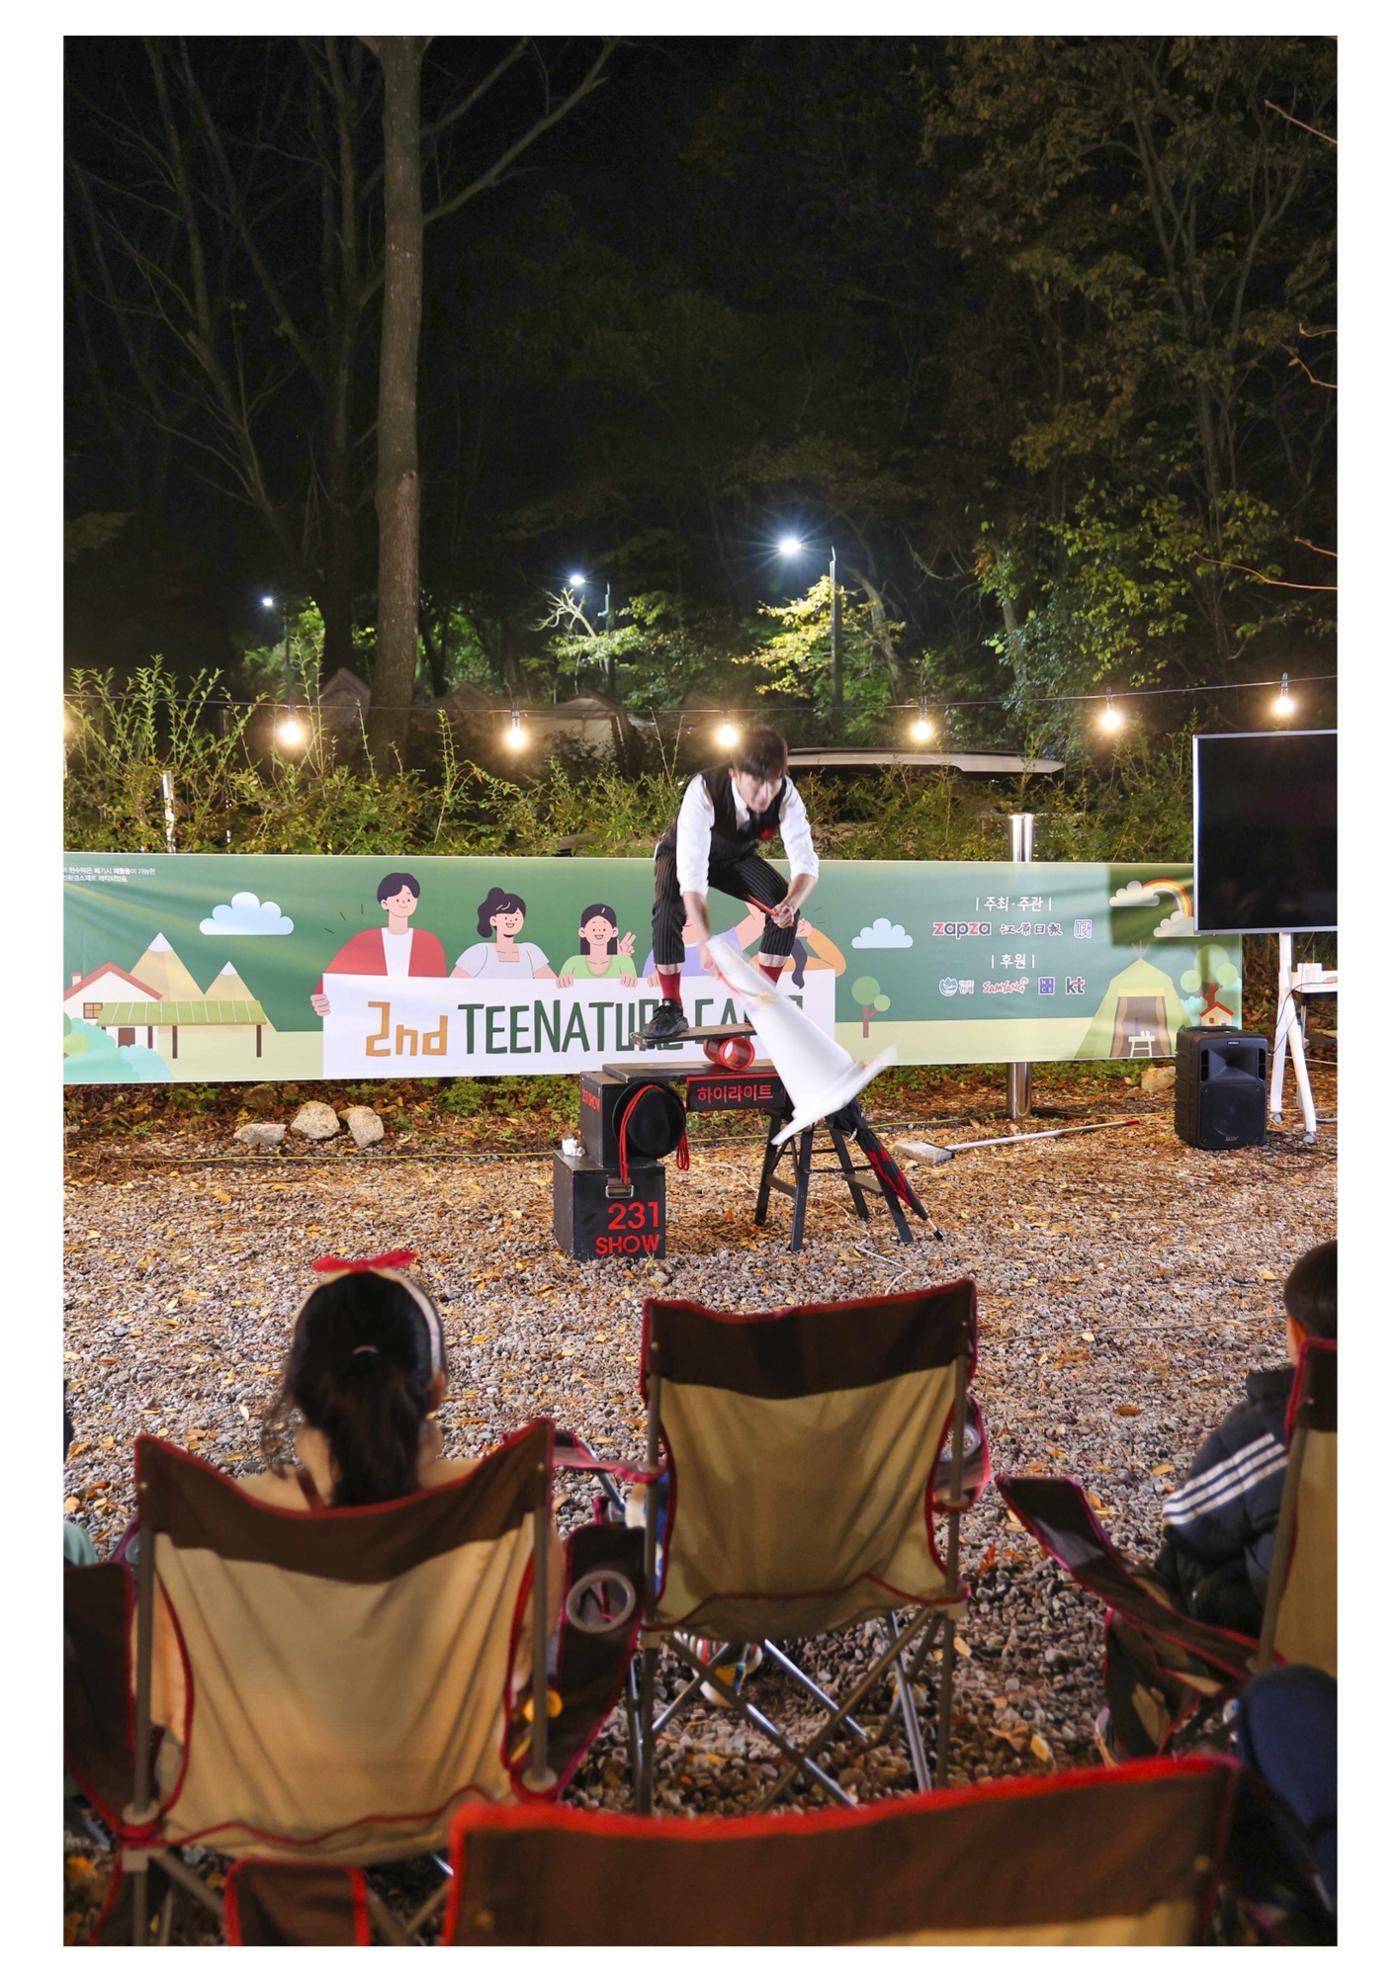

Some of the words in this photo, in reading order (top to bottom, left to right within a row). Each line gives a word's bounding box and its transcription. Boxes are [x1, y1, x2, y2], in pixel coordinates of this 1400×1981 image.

[933, 922, 992, 939] zapza
[1000, 954, 1026, 968] 후원
[1066, 978, 1085, 993] kt
[366, 1001, 448, 1056] 2nd
[697, 1084, 774, 1104] 하이라이트
[607, 1201, 659, 1230] 231
[595, 1234, 661, 1255] SHOW
